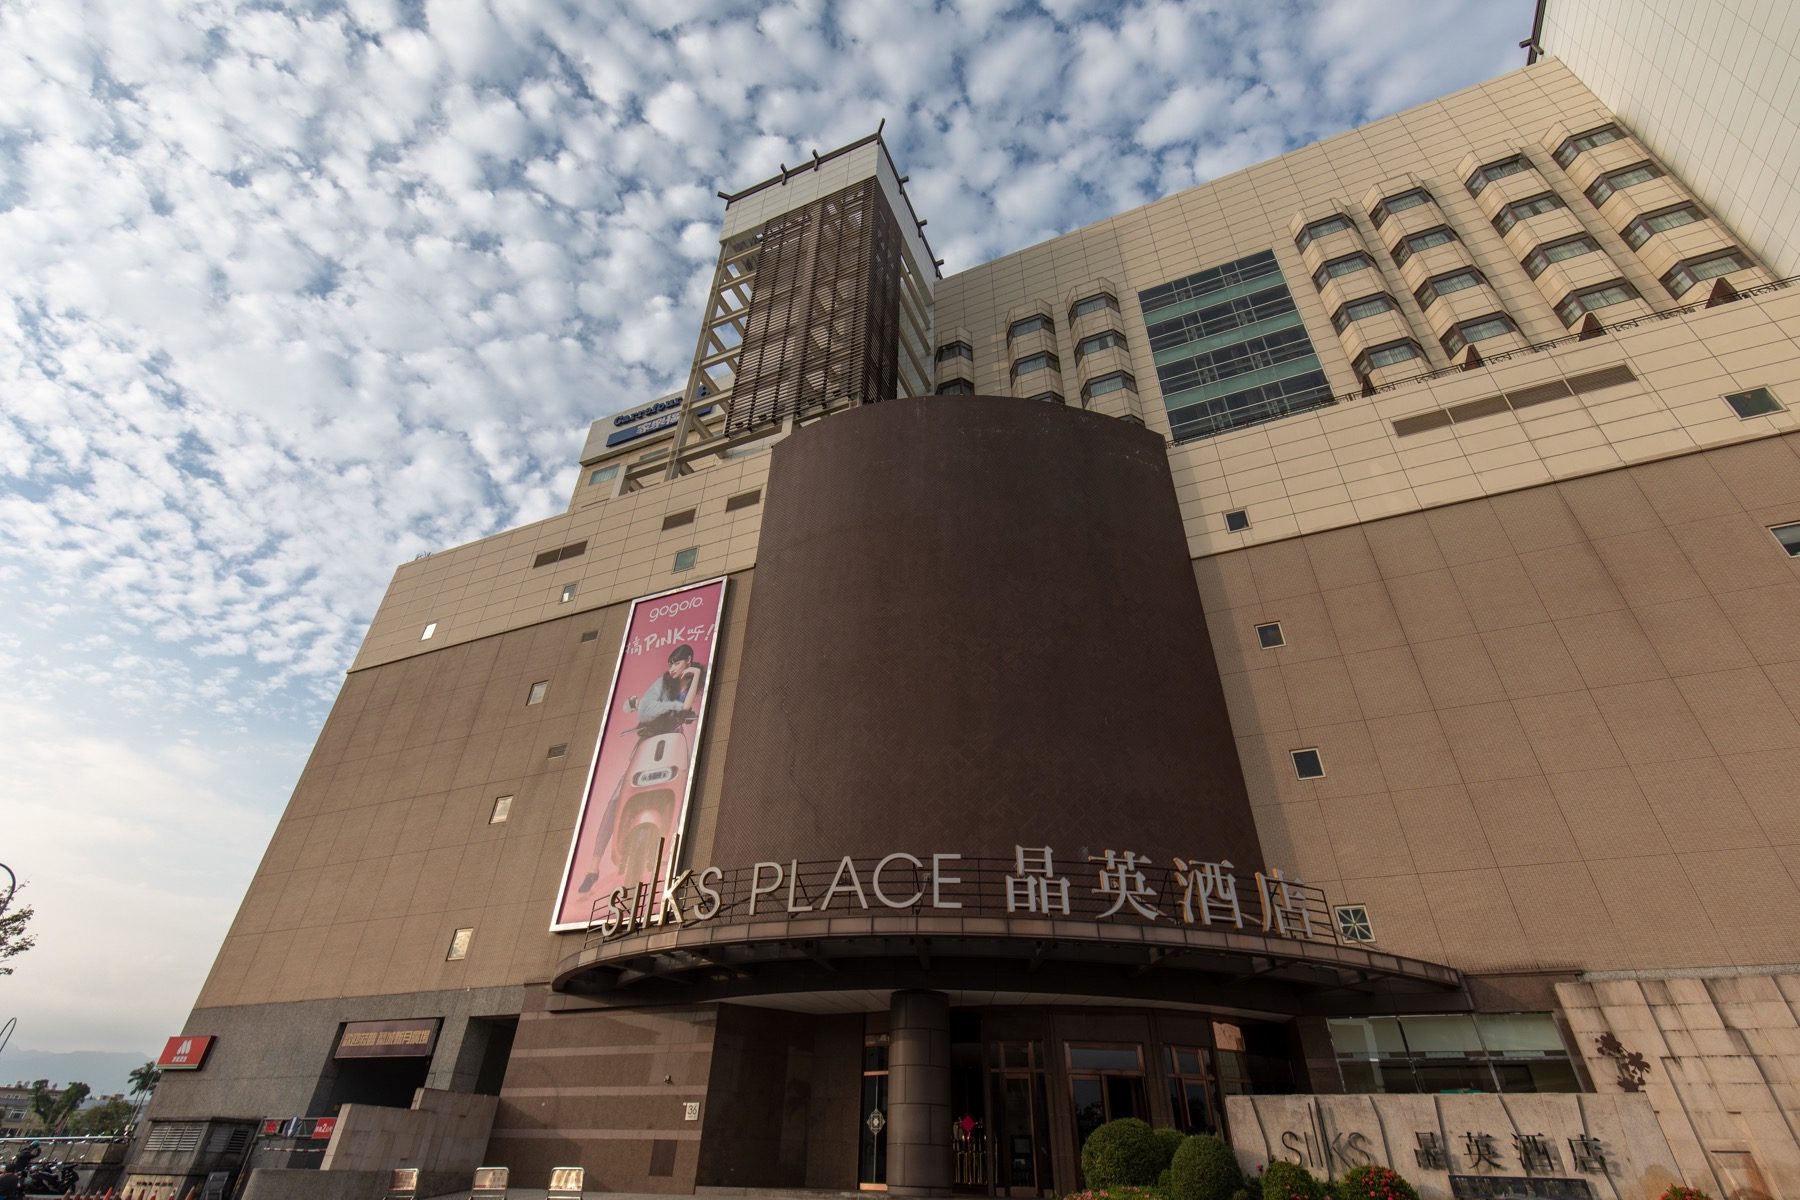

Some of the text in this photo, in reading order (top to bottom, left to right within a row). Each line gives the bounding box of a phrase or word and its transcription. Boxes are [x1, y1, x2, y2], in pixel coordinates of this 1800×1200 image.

[749, 852, 963, 917] PLACE
[1005, 844, 1314, 940] 晶英酒店
[1413, 1131, 1606, 1172] 晶英酒店
